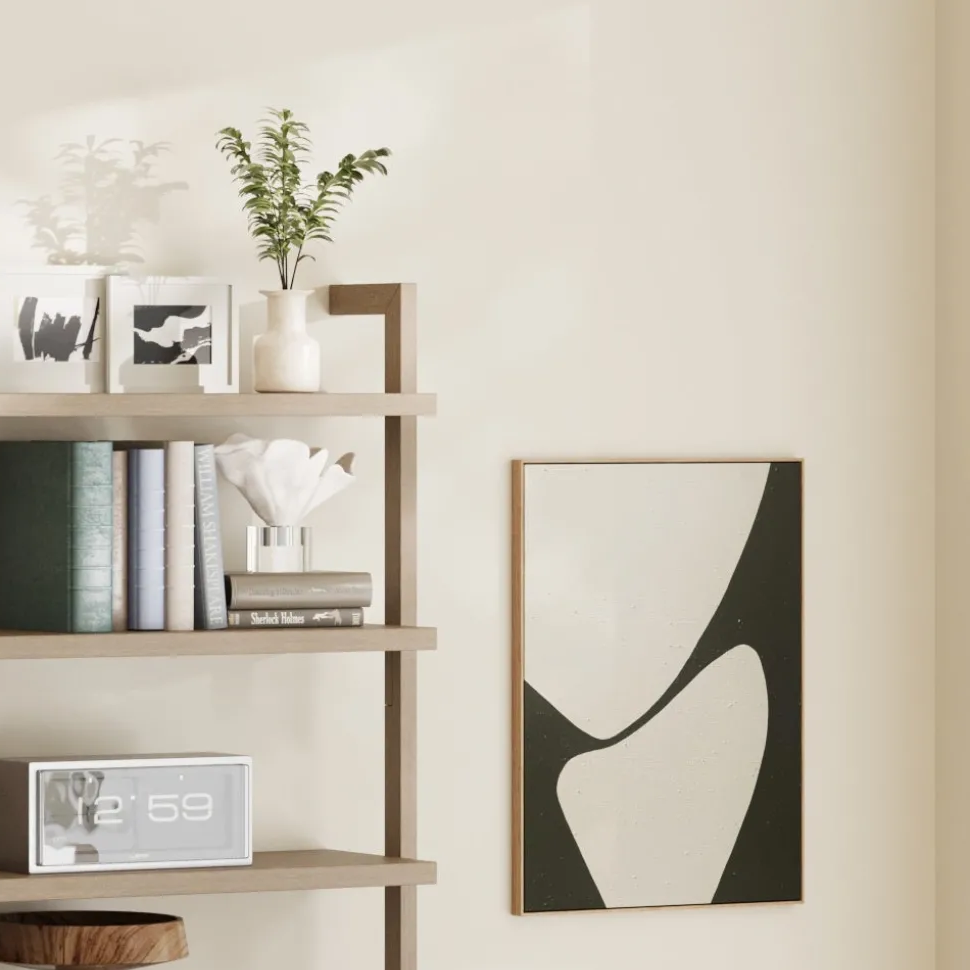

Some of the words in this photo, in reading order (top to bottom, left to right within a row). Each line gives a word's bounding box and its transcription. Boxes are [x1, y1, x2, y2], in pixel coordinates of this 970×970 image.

[197, 449, 215, 517] WILLIAM
[250, 612, 279, 625] Sherlock
[280, 611, 305, 624] Holmes
